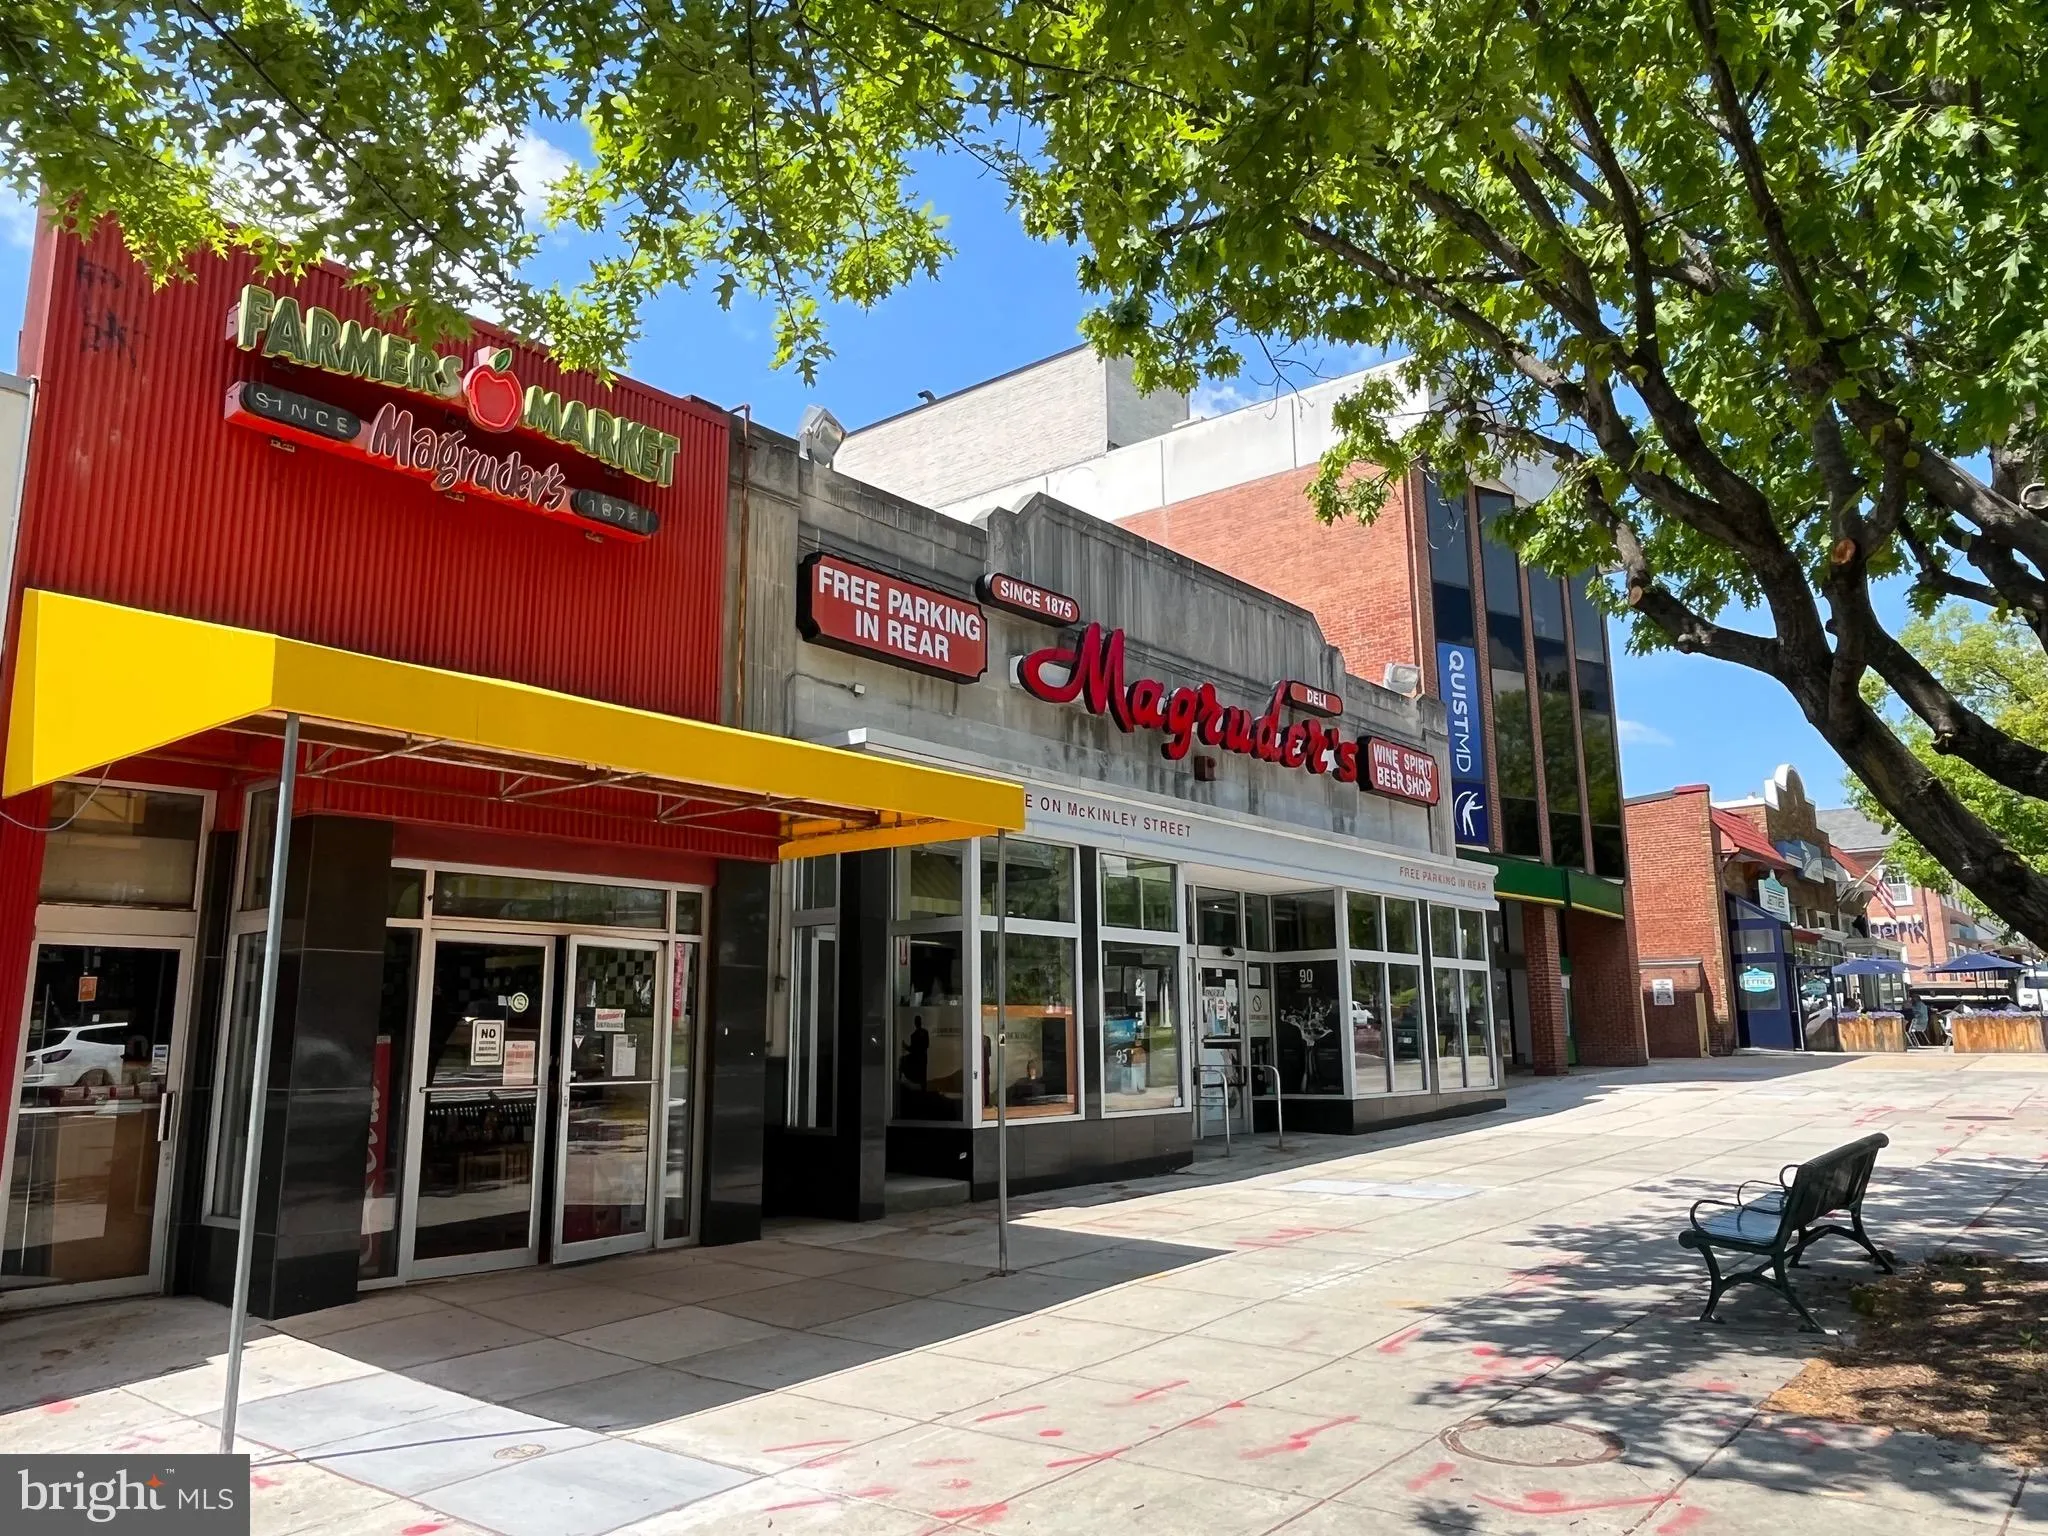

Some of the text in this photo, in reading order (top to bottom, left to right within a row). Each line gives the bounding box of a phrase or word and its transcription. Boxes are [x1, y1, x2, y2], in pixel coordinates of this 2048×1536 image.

[236, 284, 464, 398] FARMERS
[521, 385, 681, 487] MARKET
[254, 391, 349, 435] SINCE
[366, 402, 572, 512] Magruder's
[818, 565, 981, 642] FREE PARKING
[1000, 580, 1073, 618] SINCE 1875
[855, 610, 950, 662] IN REAR
[1017, 622, 1359, 782] Magruder's
[1306, 688, 1327, 709] DELI
[1448, 649, 1472, 773] QUISTMD
[1373, 743, 1433, 779] WINE SPIRIT
[1377, 766, 1432, 798] BEER SHOP
[1040, 797, 1062, 813] ON
[1068, 802, 1137, 827] McKINLEY
[1144, 817, 1191, 838] STREET
[1399, 867, 1420, 879] FREE
[1422, 871, 1456, 886] PARKING
[481, 1028, 497, 1039] NO
